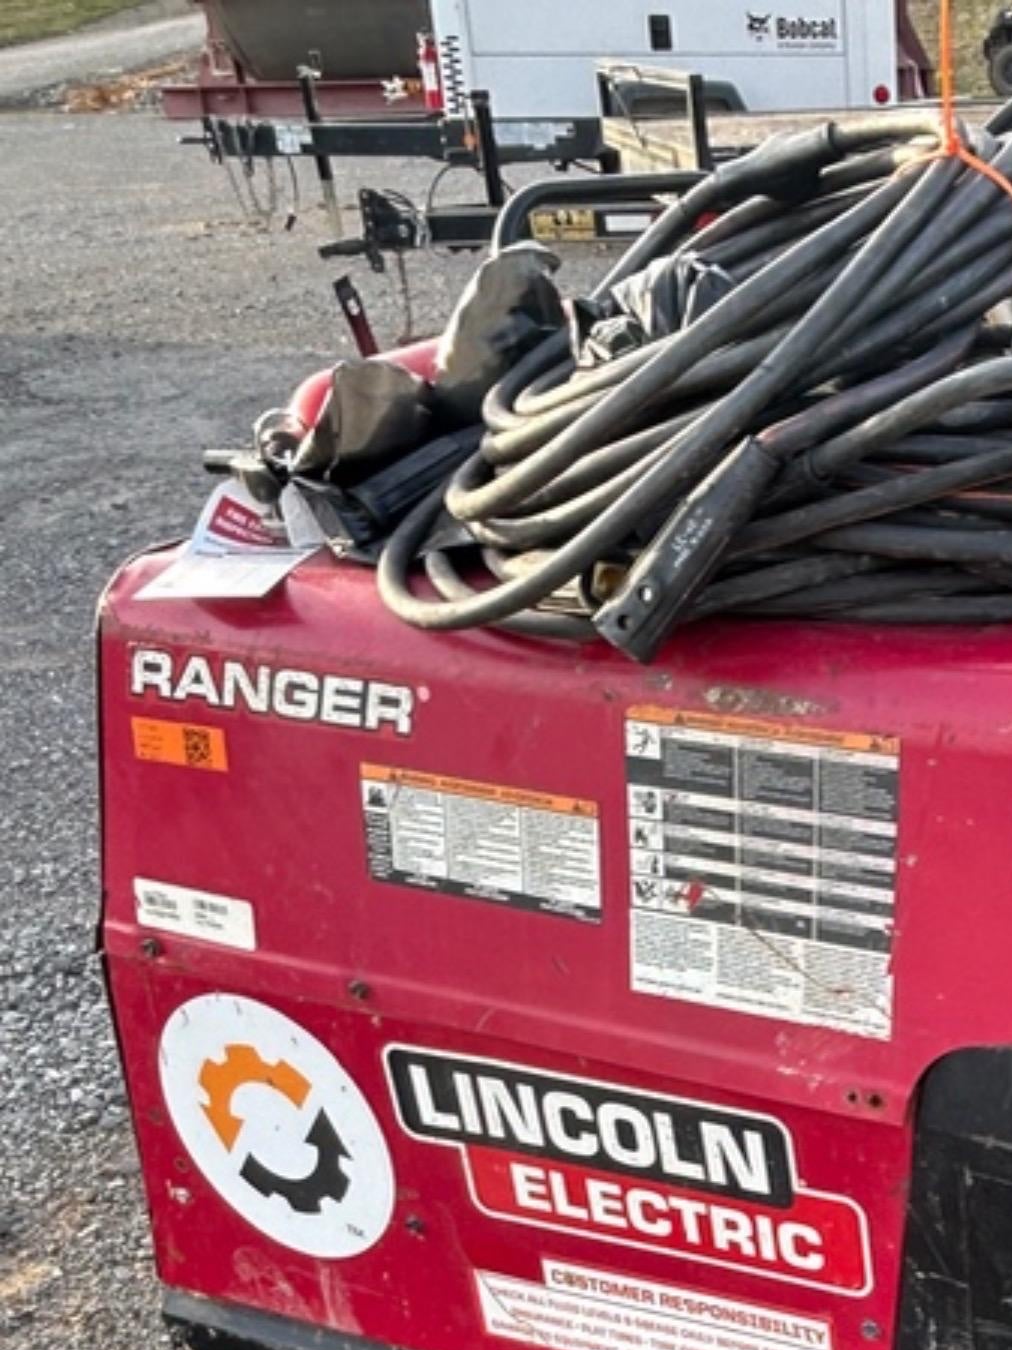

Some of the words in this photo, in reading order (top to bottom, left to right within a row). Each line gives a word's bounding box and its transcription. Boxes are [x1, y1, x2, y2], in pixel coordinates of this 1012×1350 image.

[776, 17, 837, 39] Bobcat
[130, 649, 414, 734] RANGER
[406, 1064, 771, 1196] LINCOLN
[509, 1162, 825, 1271] ELECTRIC
[549, 1266, 656, 1306] CUSTOMER
[658, 1291, 826, 1346] RESPONSIBILITY
